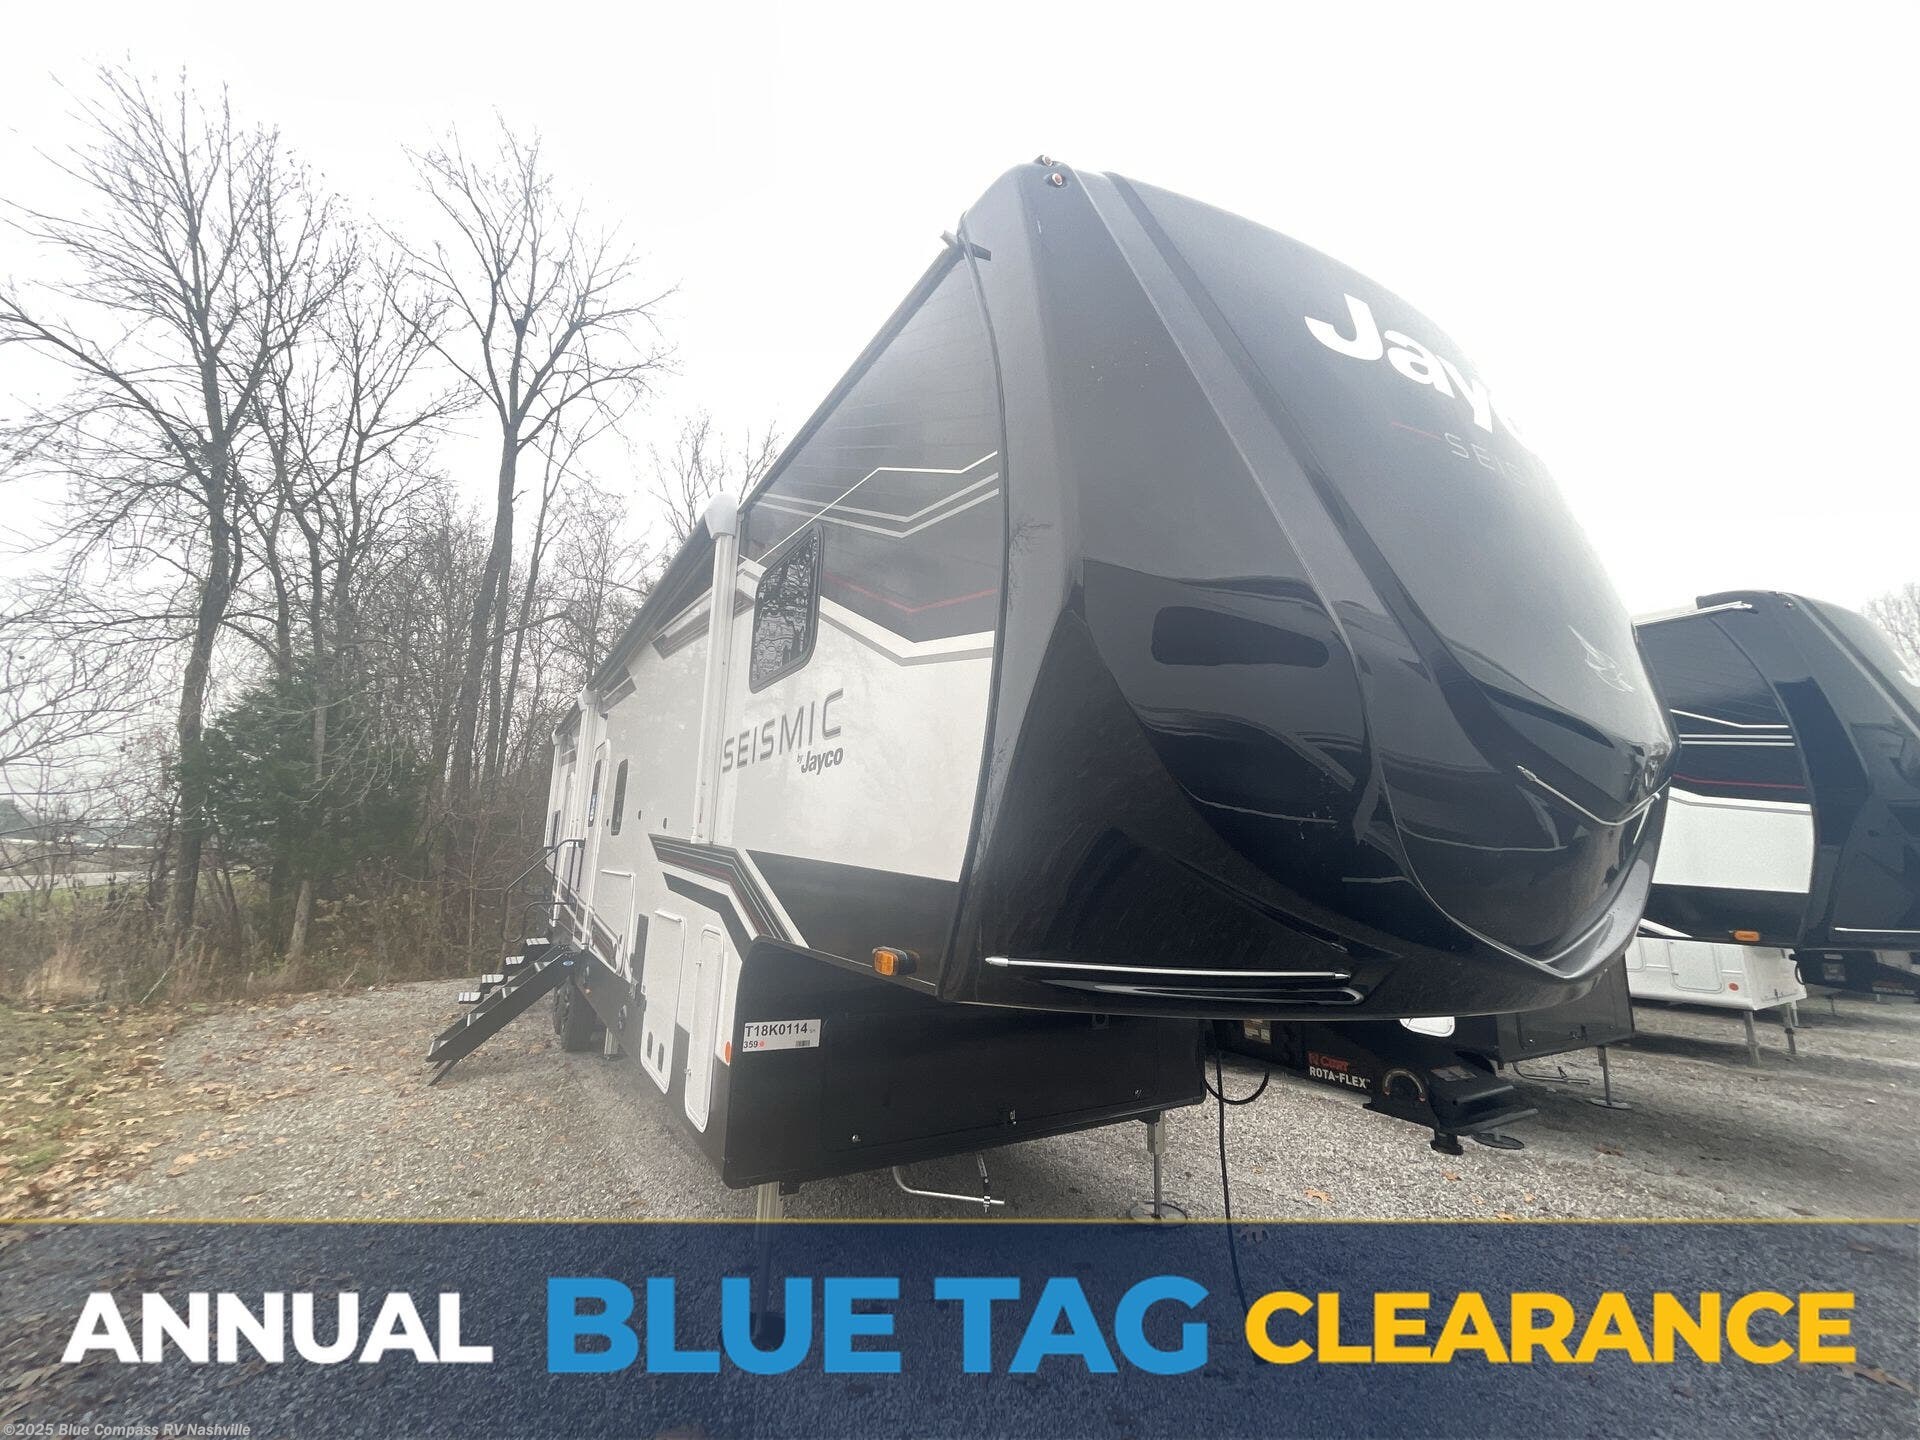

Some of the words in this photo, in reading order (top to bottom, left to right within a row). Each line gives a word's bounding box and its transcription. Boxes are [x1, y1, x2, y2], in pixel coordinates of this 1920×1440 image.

[722, 688, 843, 773] SEISMIC
[801, 747, 844, 775] Jayco
[745, 1022, 808, 1038] T18K0114
[743, 1040, 758, 1049] 359
